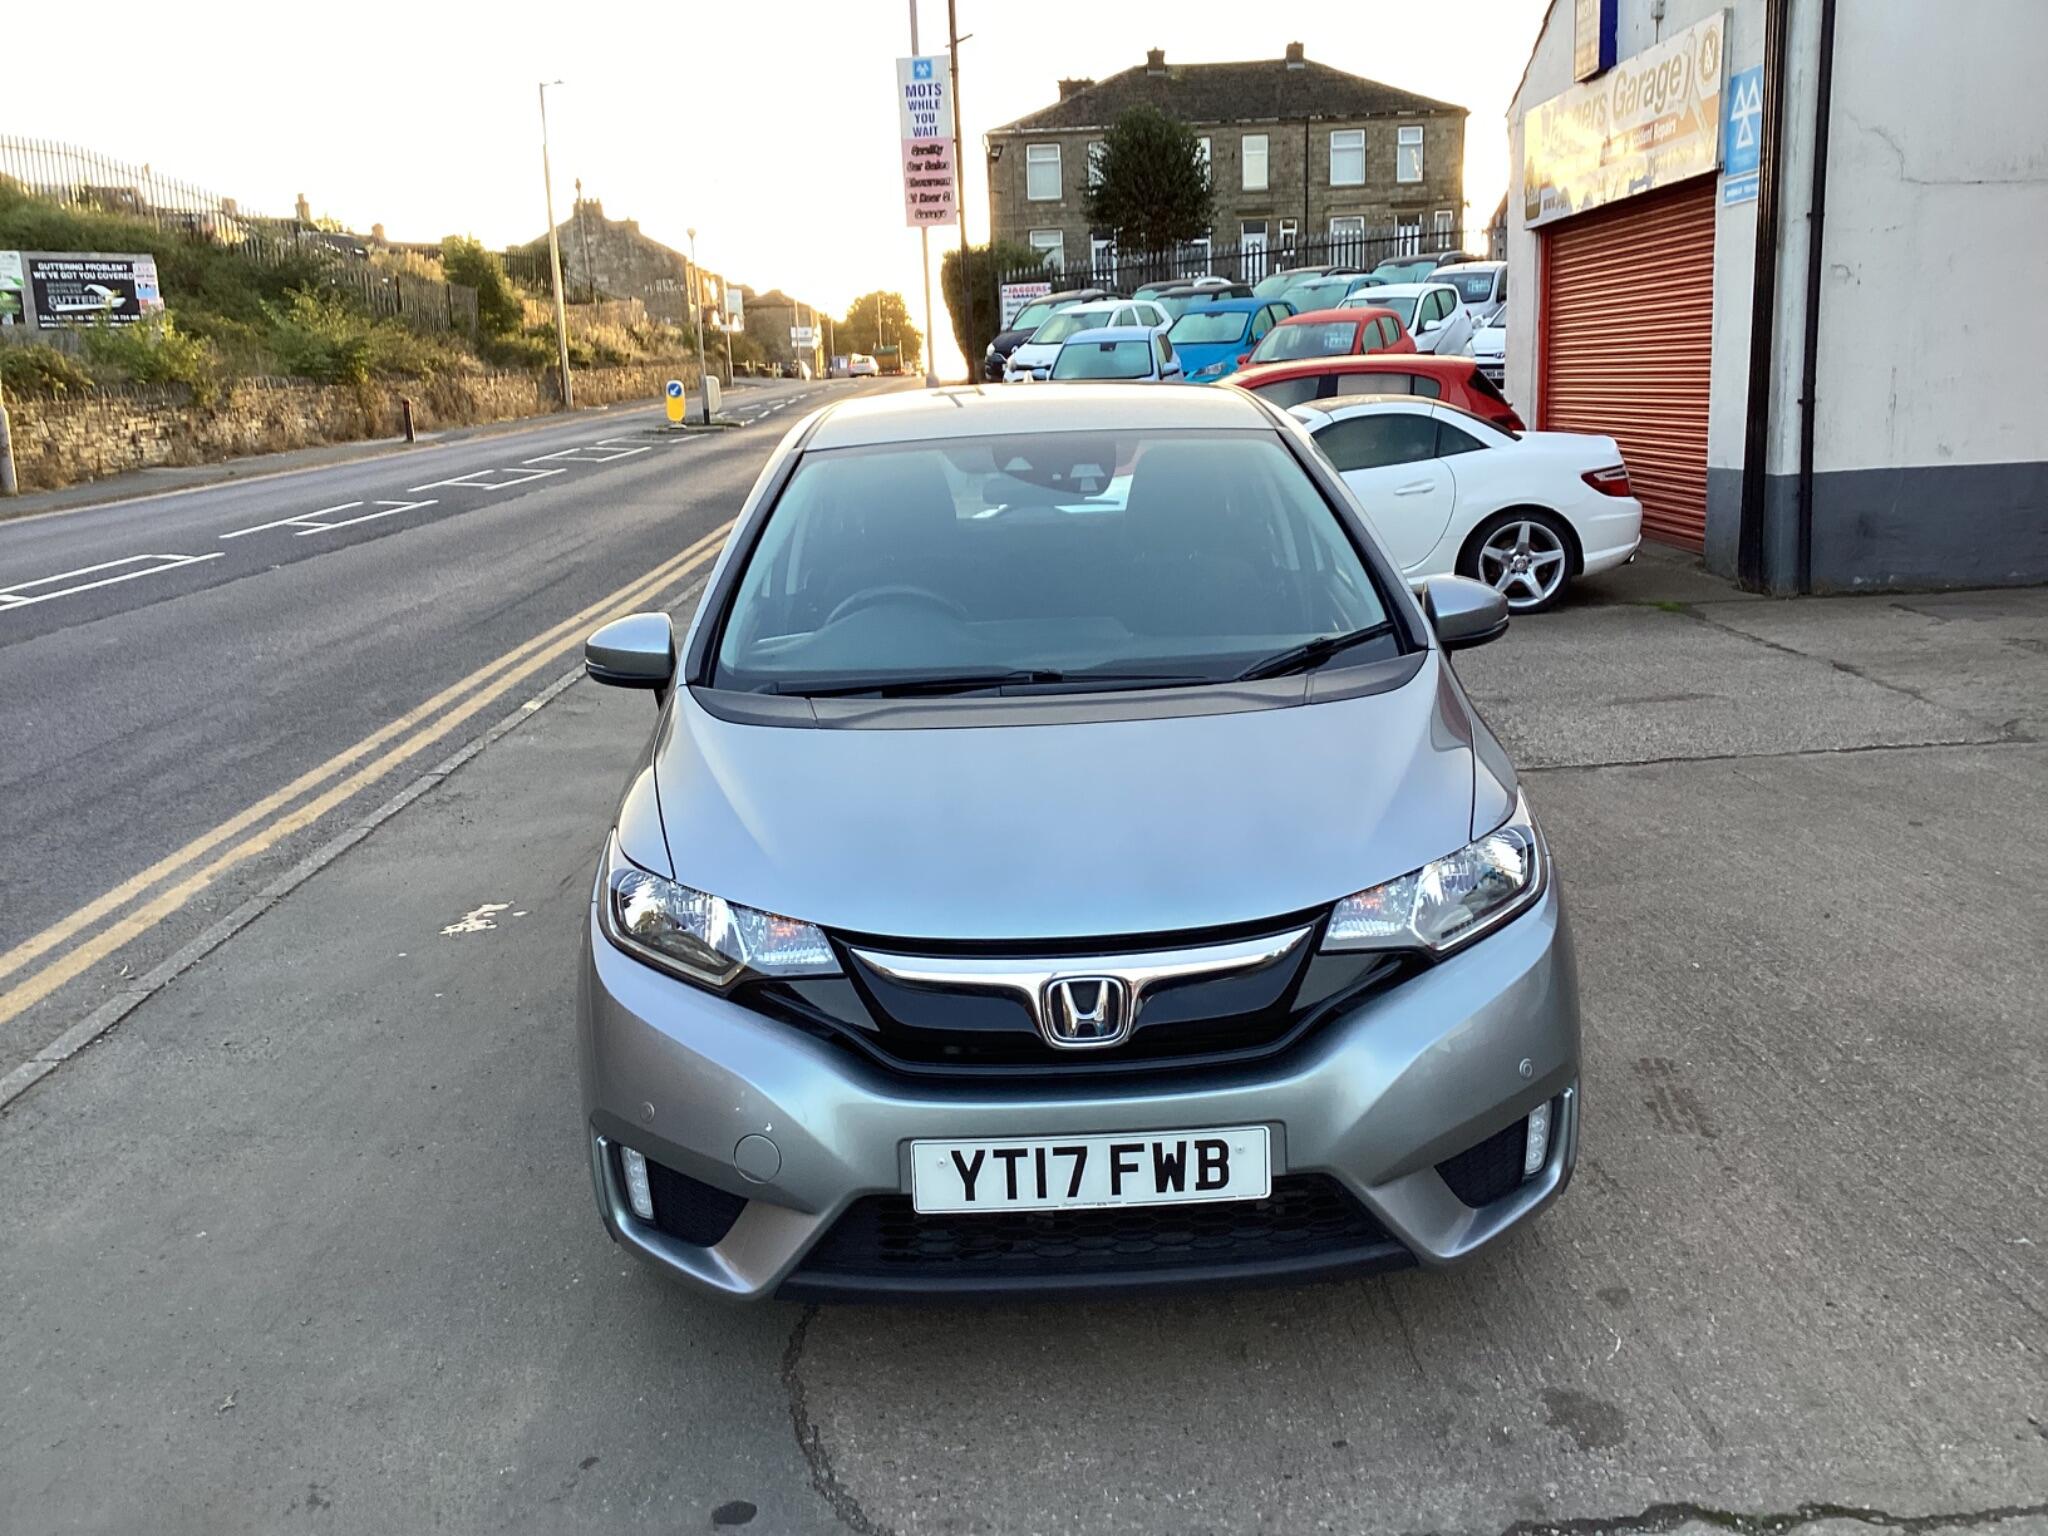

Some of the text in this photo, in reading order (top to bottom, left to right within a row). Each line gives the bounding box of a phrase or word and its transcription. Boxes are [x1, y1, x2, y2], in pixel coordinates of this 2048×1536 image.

[905, 83, 942, 98] MOTS
[1612, 53, 1683, 119] Garage
[908, 98, 941, 111] WHILE
[914, 112, 936, 124] YOU
[913, 126, 939, 138] WAIT
[37, 263, 128, 271] GUTTERING PROBLEM?
[32, 271, 134, 280] WE'VE GOT YOU COVERED
[1008, 286, 1047, 294] JAGGERS
[950, 1139, 1230, 1202] YT17 FWB
